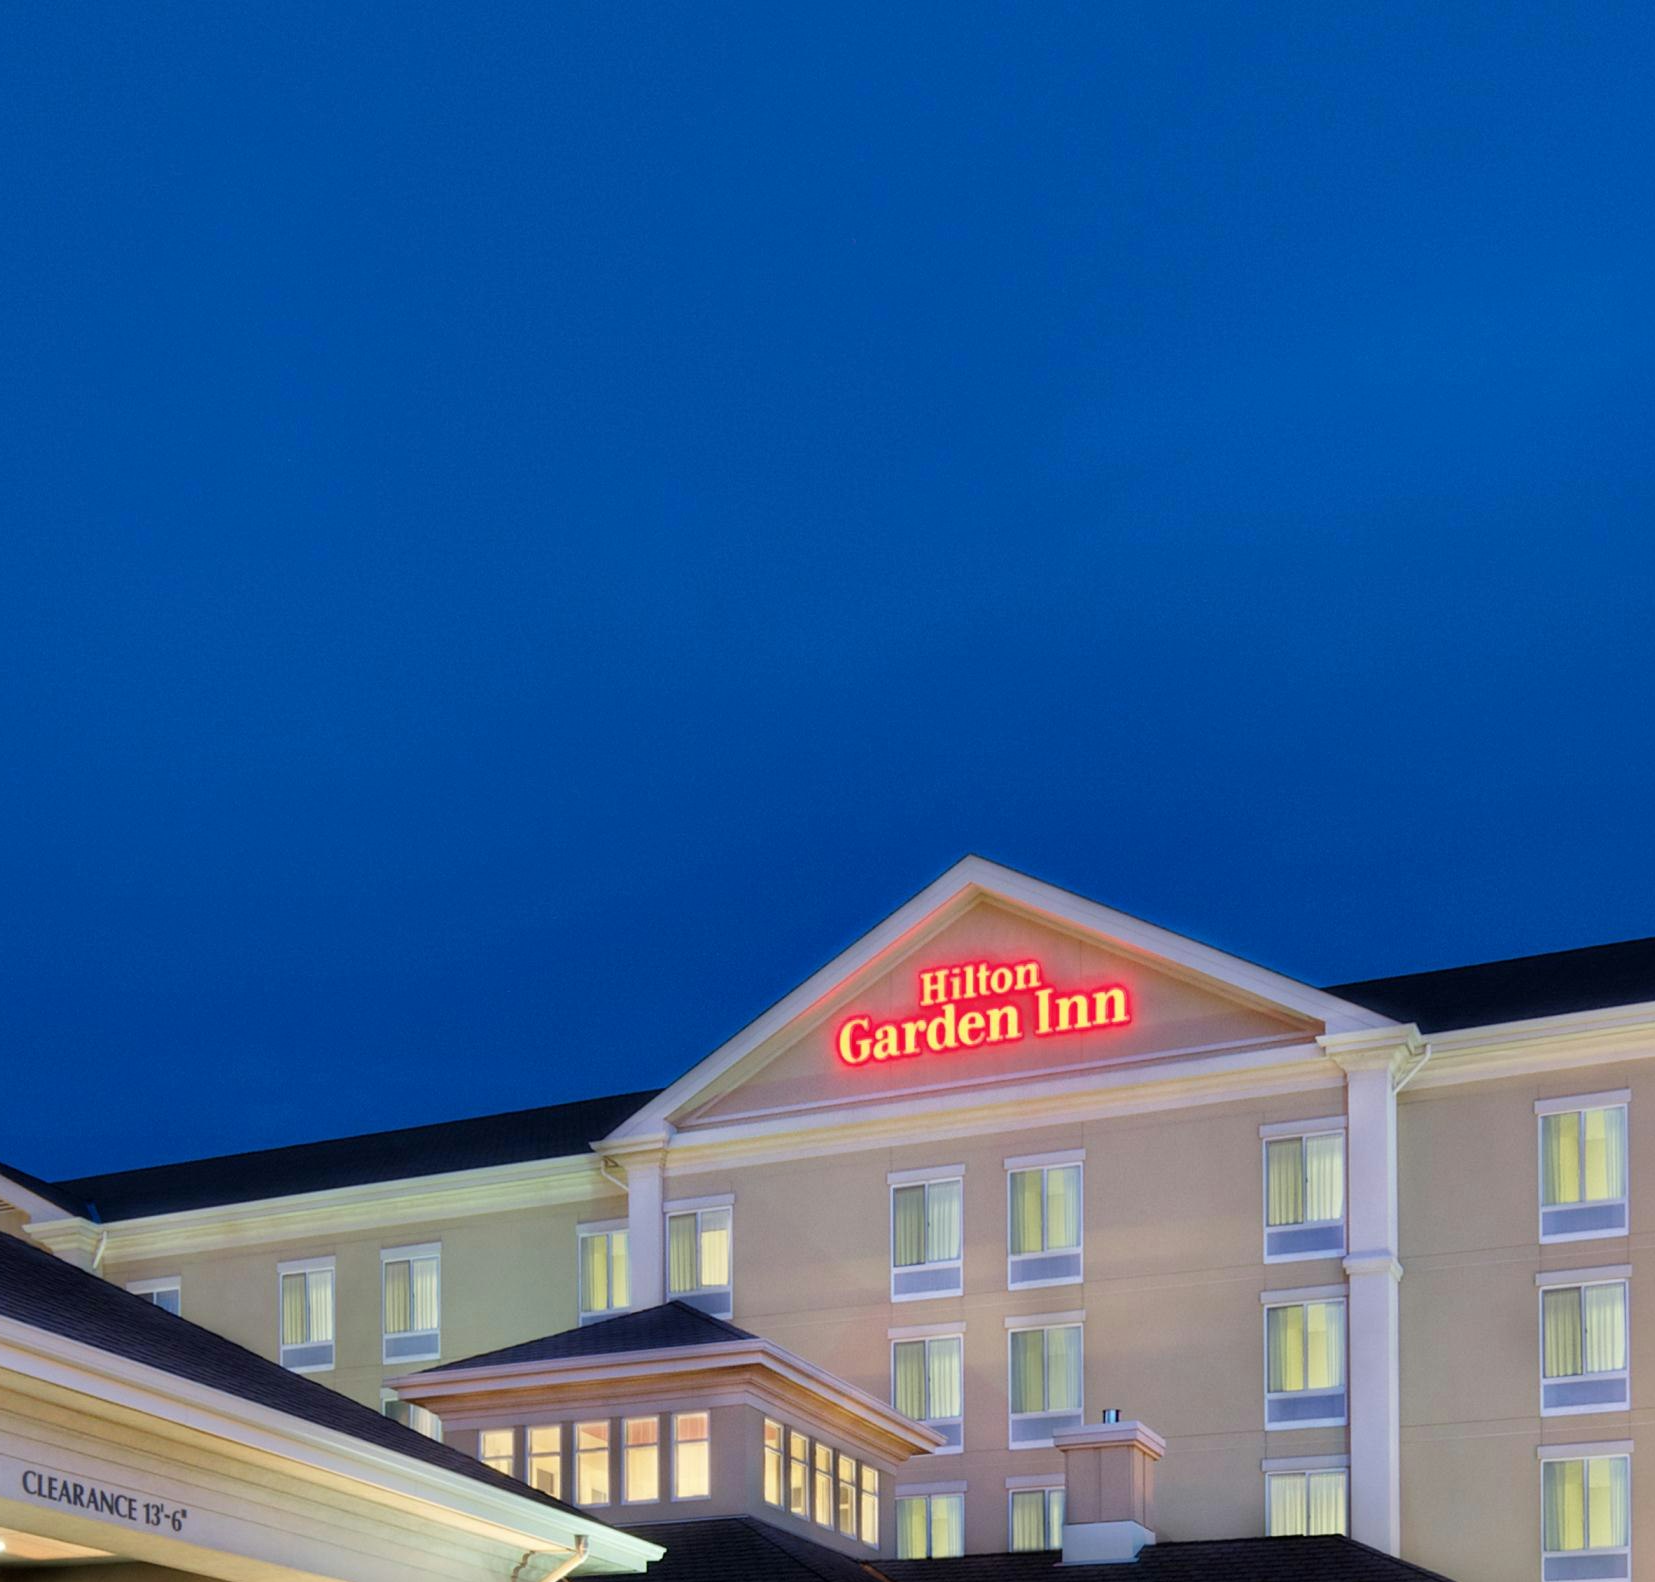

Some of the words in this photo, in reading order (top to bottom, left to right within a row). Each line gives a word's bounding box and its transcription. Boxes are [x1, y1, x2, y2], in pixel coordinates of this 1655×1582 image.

[919, 961, 1042, 1007] Hilton
[838, 1003, 1023, 1065] Garden
[1034, 985, 1131, 1035] Inn
[21, 1469, 138, 1521] CLEARANCE
[142, 1502, 188, 1532] 13'-6"
